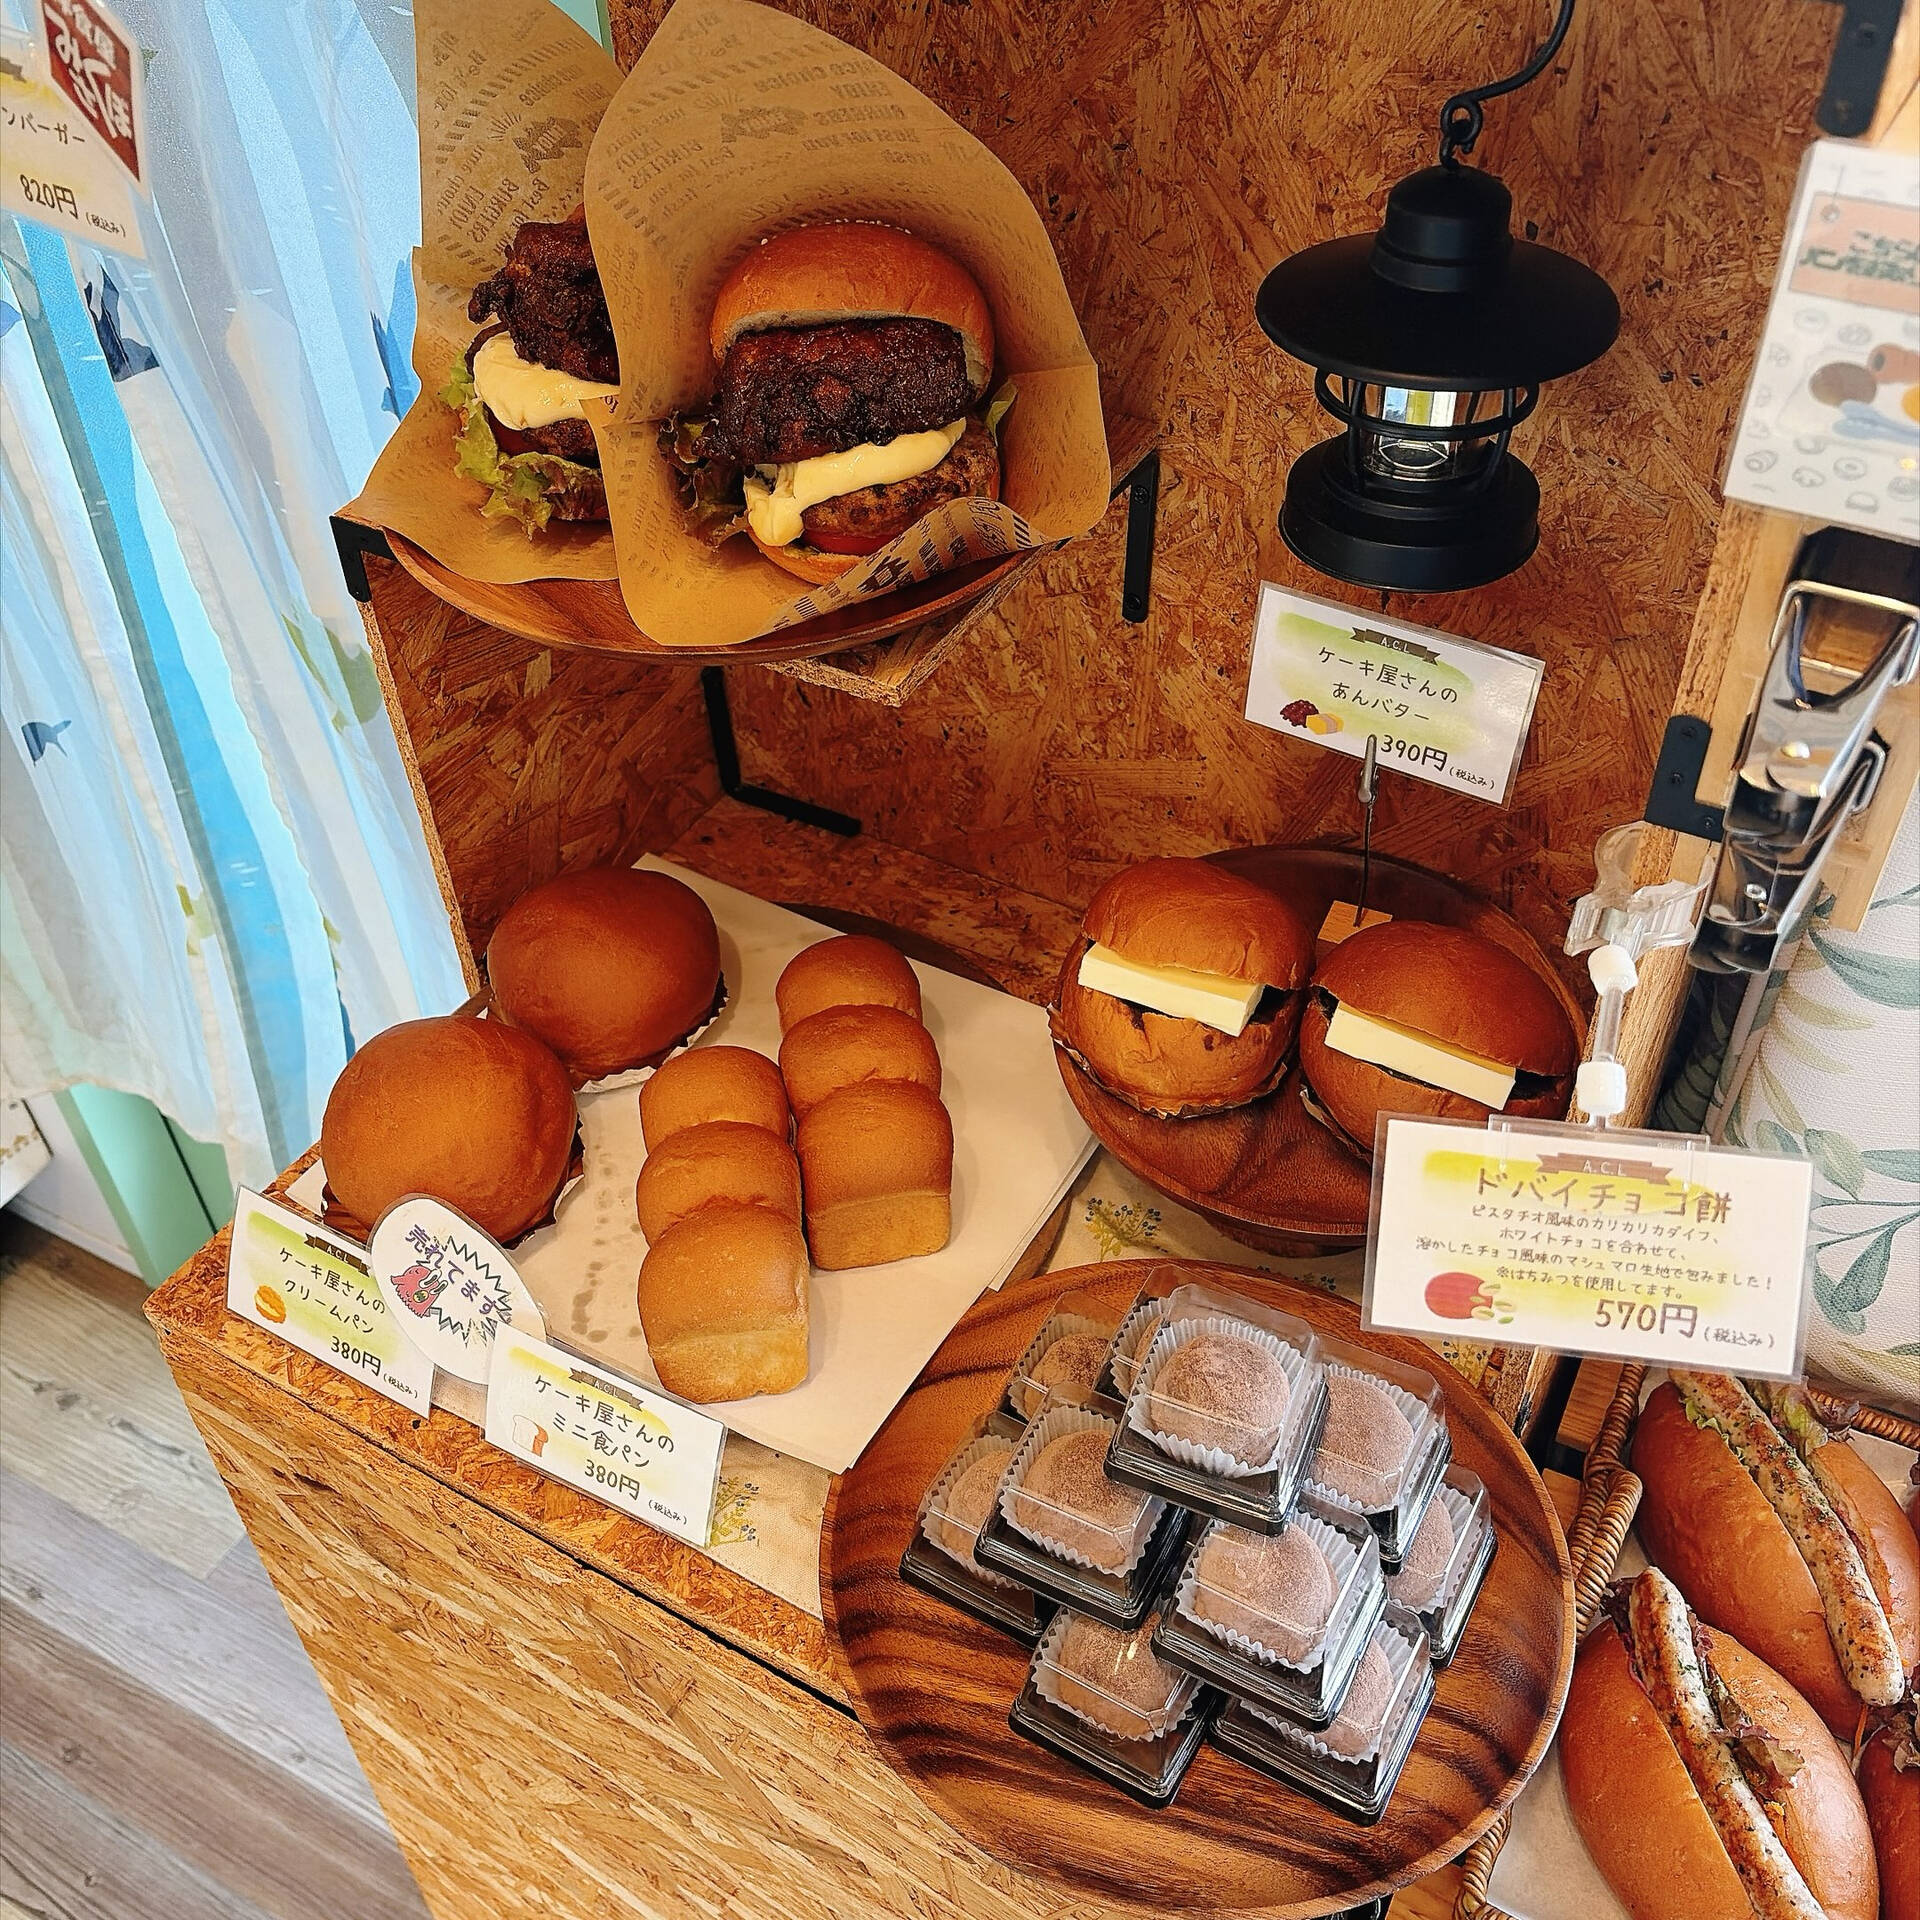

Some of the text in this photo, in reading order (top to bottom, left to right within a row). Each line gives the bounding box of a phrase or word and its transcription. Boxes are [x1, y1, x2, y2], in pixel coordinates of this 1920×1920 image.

[20, 173, 79, 220] 820円
[1318, 646, 1458, 704] ケーキ屋さんの
[1332, 682, 1430, 721] あんバター
[1380, 735, 1495, 790] 390円 (税込み)
[1477, 1167, 1733, 1224] ドバイチョコ餅
[1472, 1204, 1720, 1244] ピスタチオ風味のカリカリカダイフ、
[1499, 1227, 1686, 1260] ホワイトチョコを合わせて、
[279, 1247, 386, 1314] ケーキ屋さんの
[405, 1224, 497, 1315] 売れてます
[285, 1280, 374, 1334] クリームパン
[1594, 1298, 1775, 1349] 570円 (税込み)
[330, 1336, 382, 1377] 380円
[535, 1374, 675, 1453] ケーキ屋さんの
[552, 1412, 650, 1468] ミニ食パン
[584, 1459, 688, 1525] 380円 (税込み)
